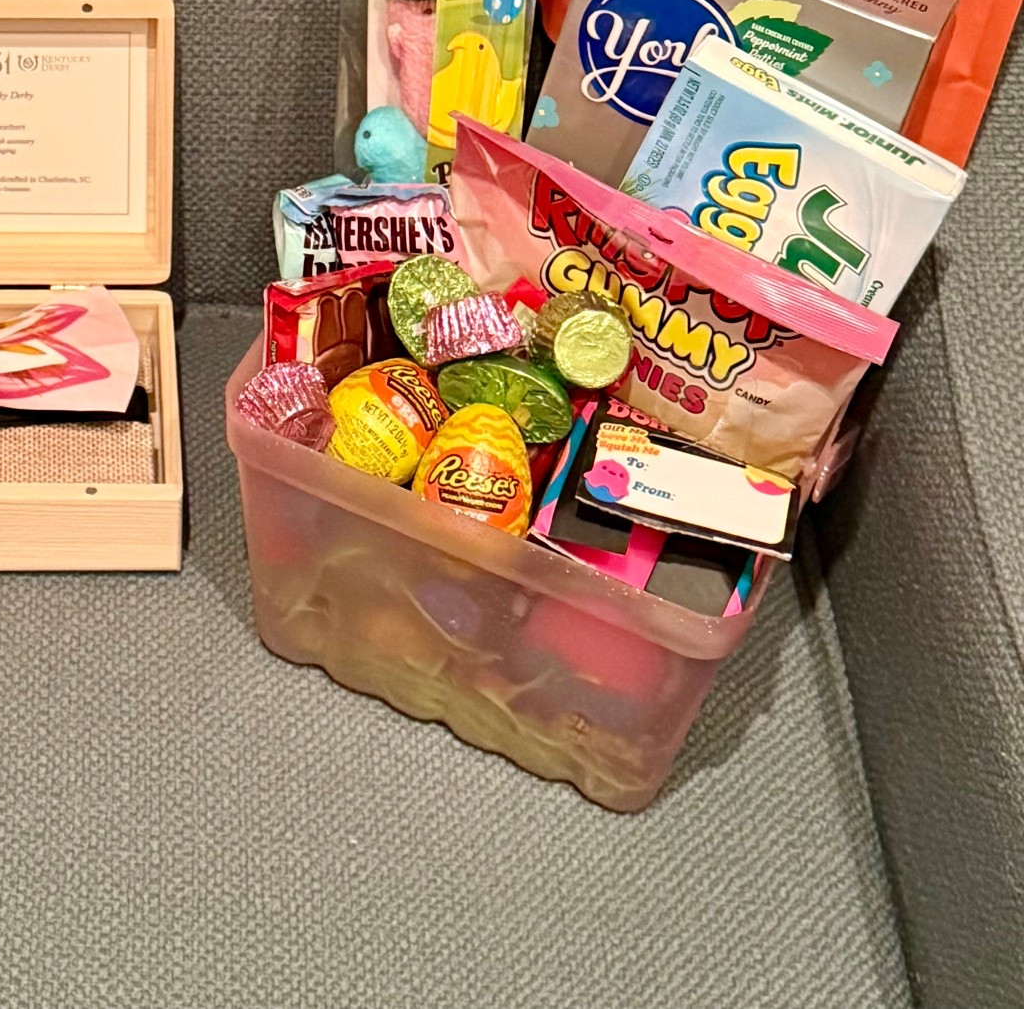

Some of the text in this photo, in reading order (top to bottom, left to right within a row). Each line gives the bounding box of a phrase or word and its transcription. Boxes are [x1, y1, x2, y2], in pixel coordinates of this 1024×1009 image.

[743, 30, 808, 63] Peppermint
[41, 55, 92, 64] KENTUCKY
[730, 57, 781, 92] Eggs
[10, 91, 34, 101] Derby
[786, 88, 838, 120] Mints
[546, 247, 748, 381] GUMMY
[735, 387, 773, 408] CANDY
[602, 423, 647, 436] Gift Me
[599, 440, 661, 456] Squish Me
[626, 456, 649, 472] To:
[428, 454, 520, 500] Reese's
[632, 481, 676, 502] From:
